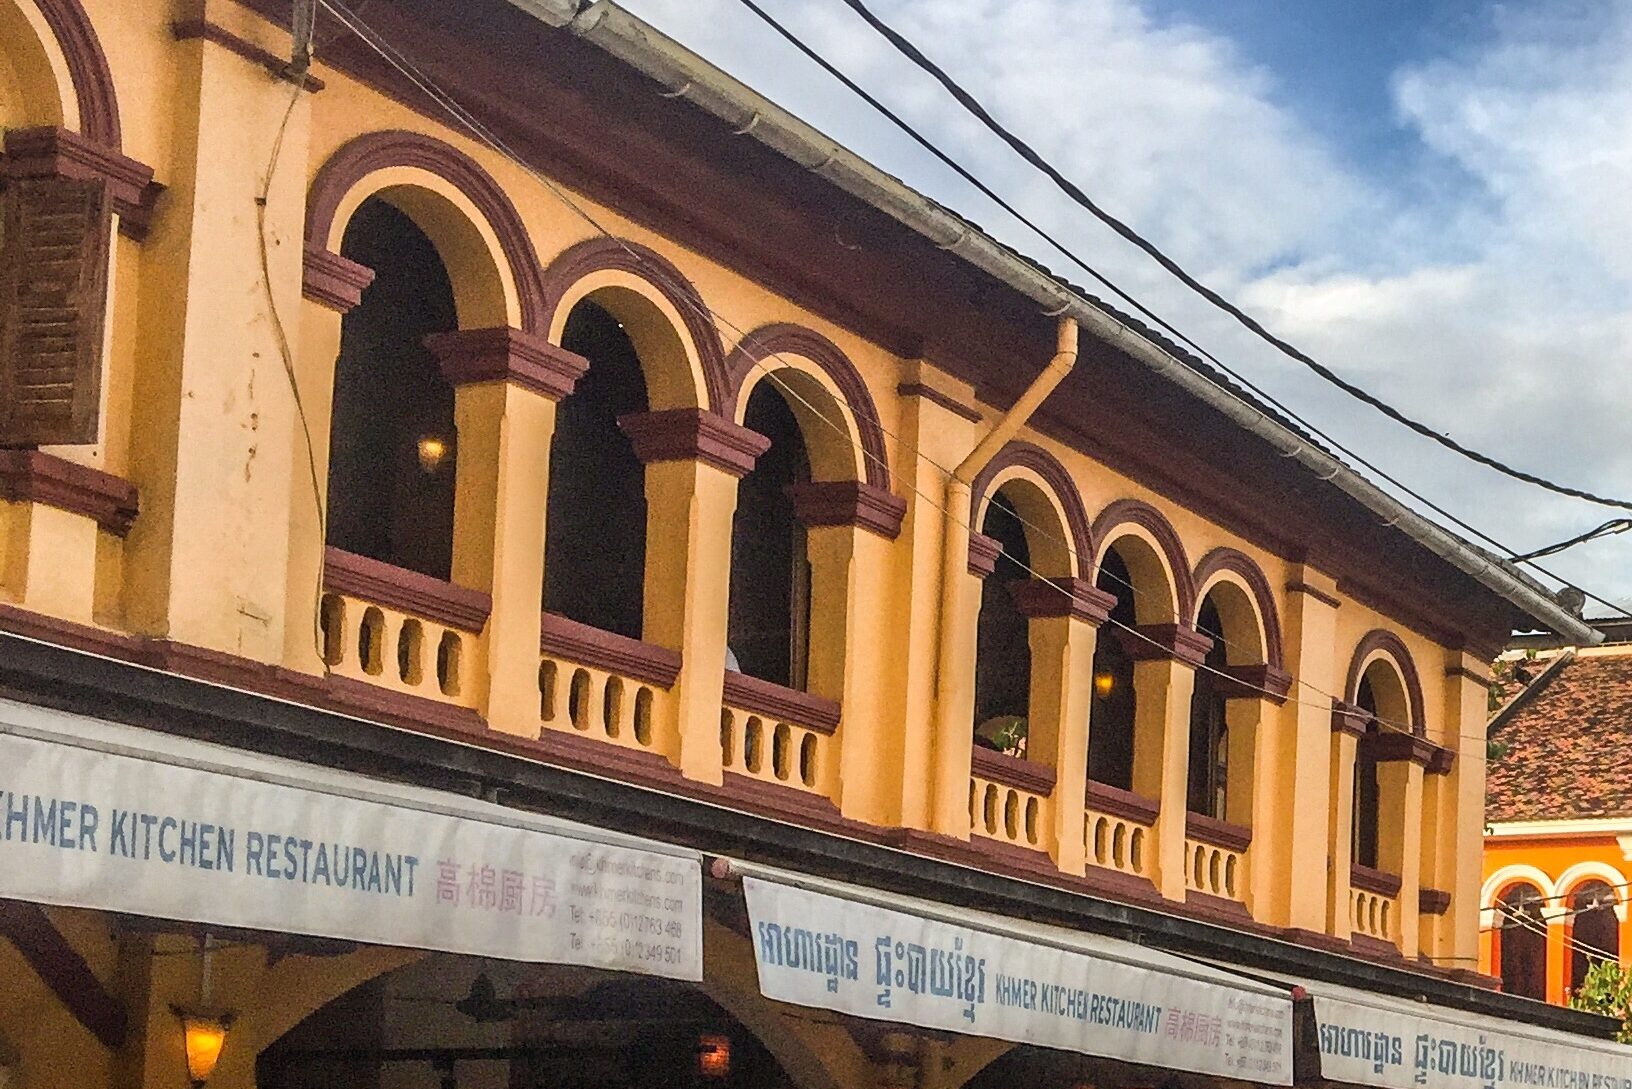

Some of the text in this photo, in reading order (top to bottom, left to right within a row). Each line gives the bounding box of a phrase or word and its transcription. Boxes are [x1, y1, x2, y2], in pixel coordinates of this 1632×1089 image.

[0, 791, 418, 897] HMER KITCHEN RESTAURANT
[995, 974, 1161, 1034] KHMER KITCHEN RESTAURANT
[1509, 1060, 1545, 1086] KHMER
